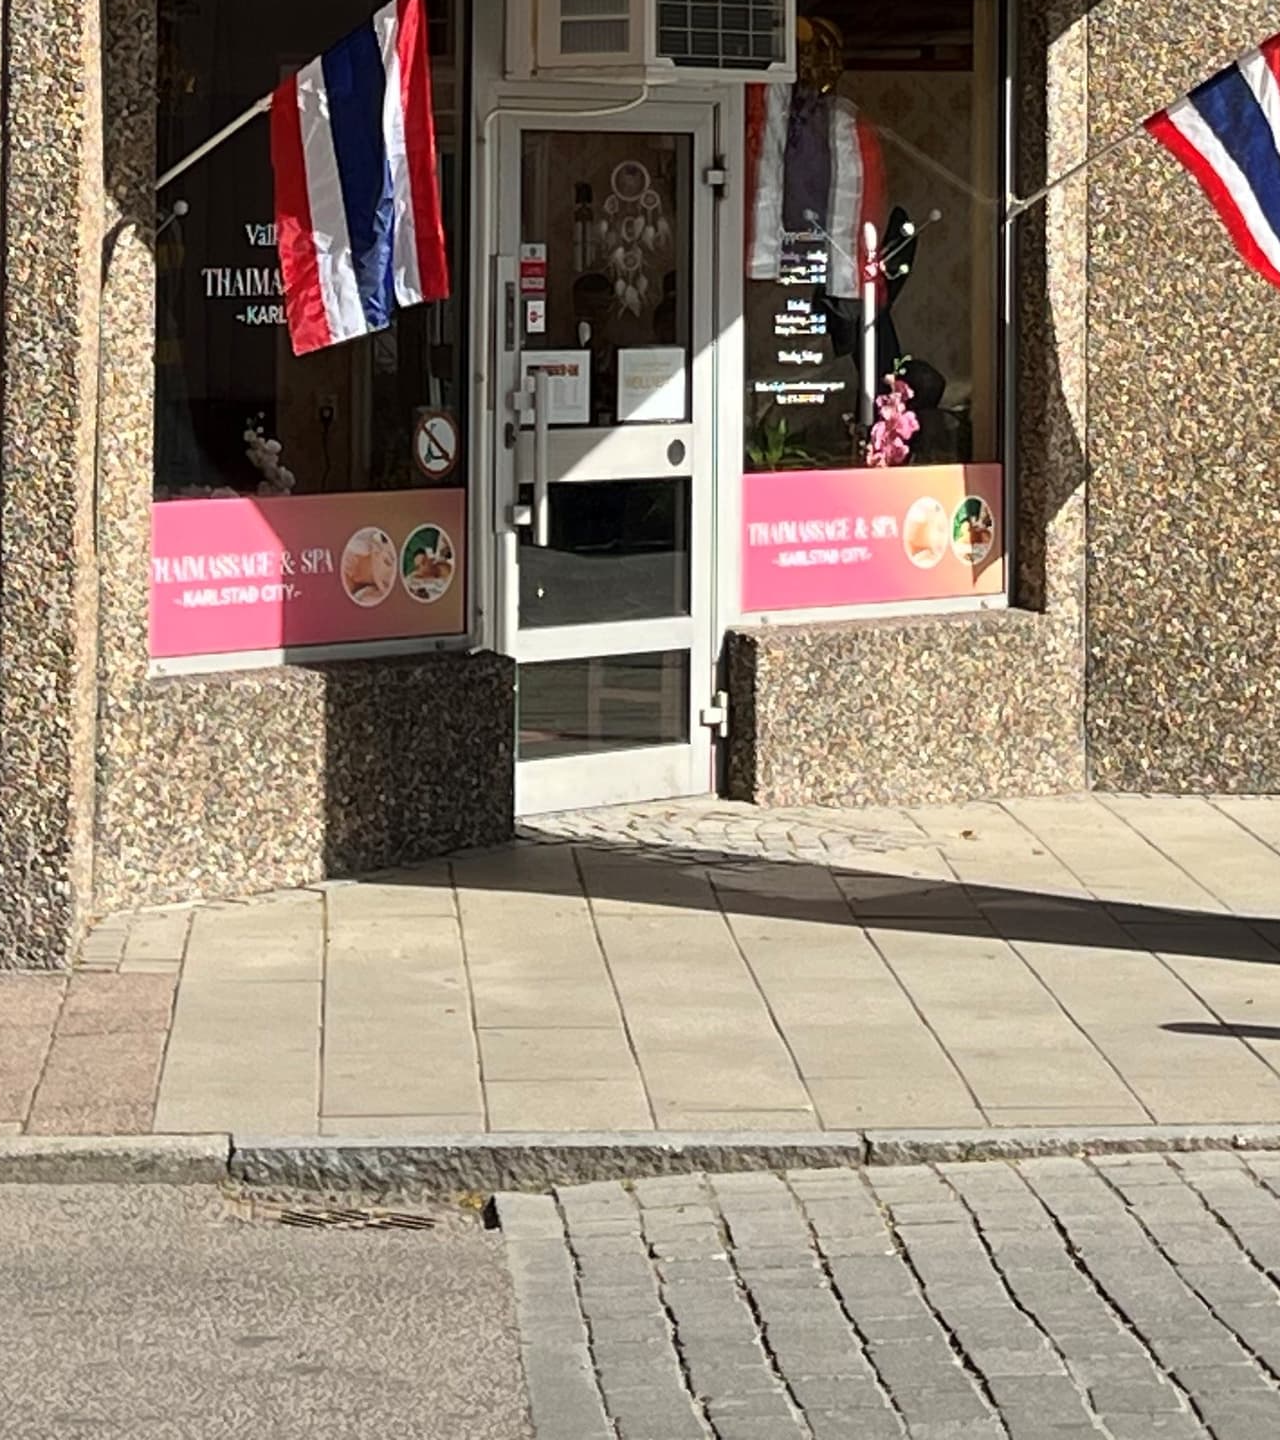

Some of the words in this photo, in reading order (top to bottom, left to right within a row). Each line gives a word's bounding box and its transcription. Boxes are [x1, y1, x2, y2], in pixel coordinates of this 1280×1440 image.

[201, 267, 284, 297] THAIMA
[154, 551, 274, 583] HAIMASSAGE
[281, 551, 297, 576] &
[301, 547, 334, 574] SPA
